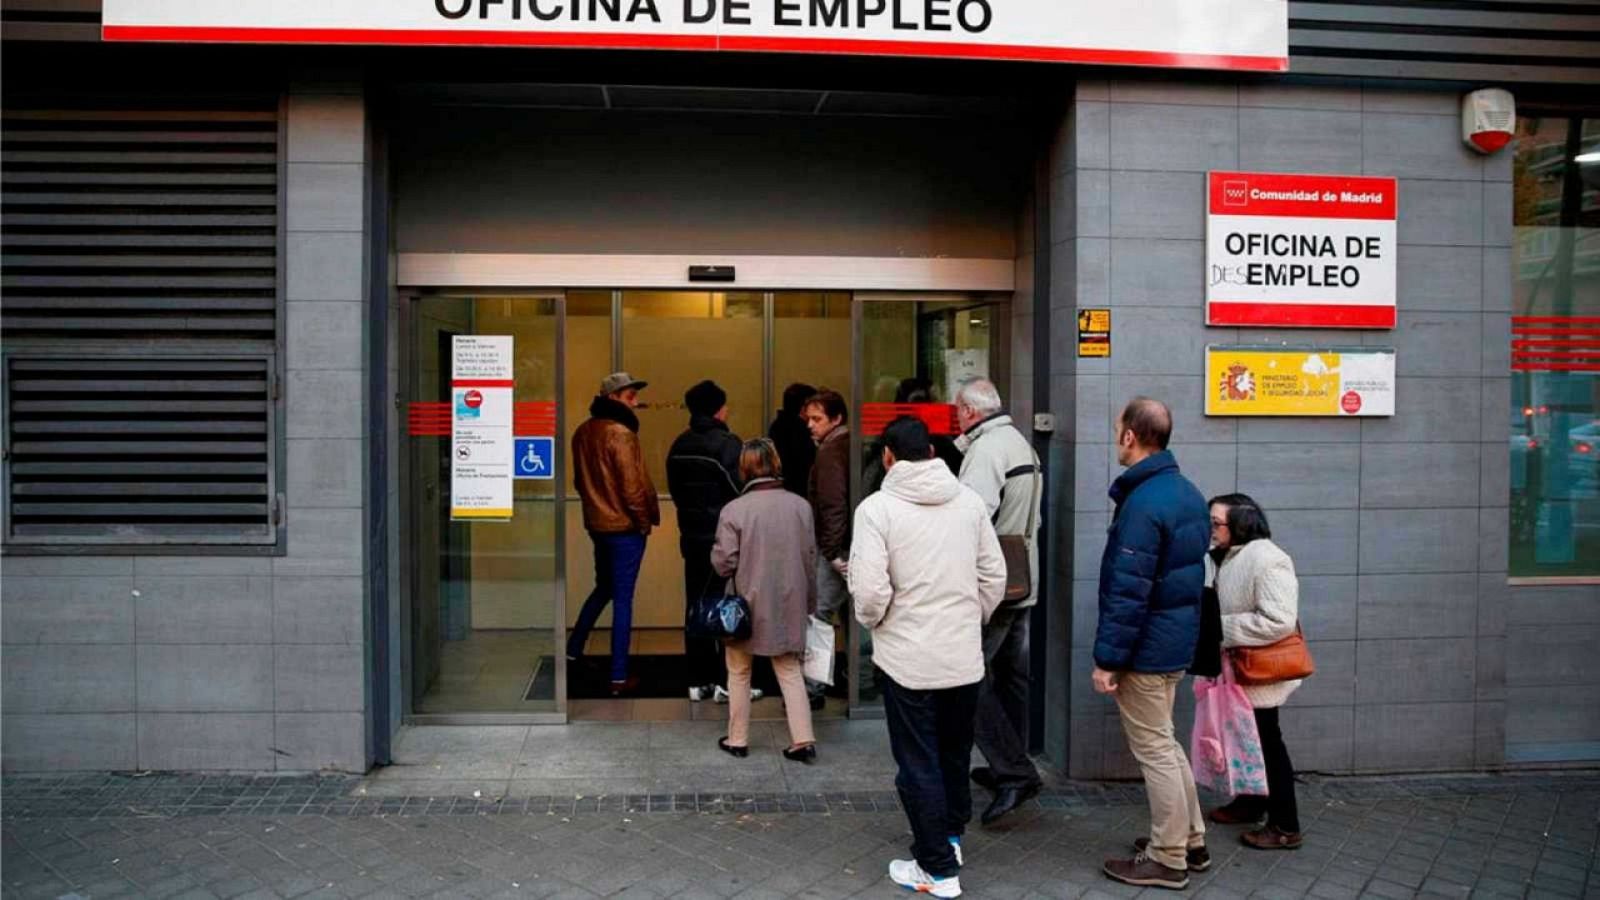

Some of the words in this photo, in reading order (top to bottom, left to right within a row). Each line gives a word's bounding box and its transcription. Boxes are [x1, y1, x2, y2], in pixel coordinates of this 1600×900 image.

[434, 0, 661, 22] OFICINA
[682, 0, 752, 24] DE
[774, 0, 992, 33] EMPLEO
[1250, 188, 1320, 202] Comunidad
[1322, 191, 1337, 202] de
[1340, 191, 1382, 204] Madrid
[1225, 232, 1336, 257] OFICINA
[1345, 236, 1381, 258] DE
[1247, 264, 1360, 288] EMPLEO
